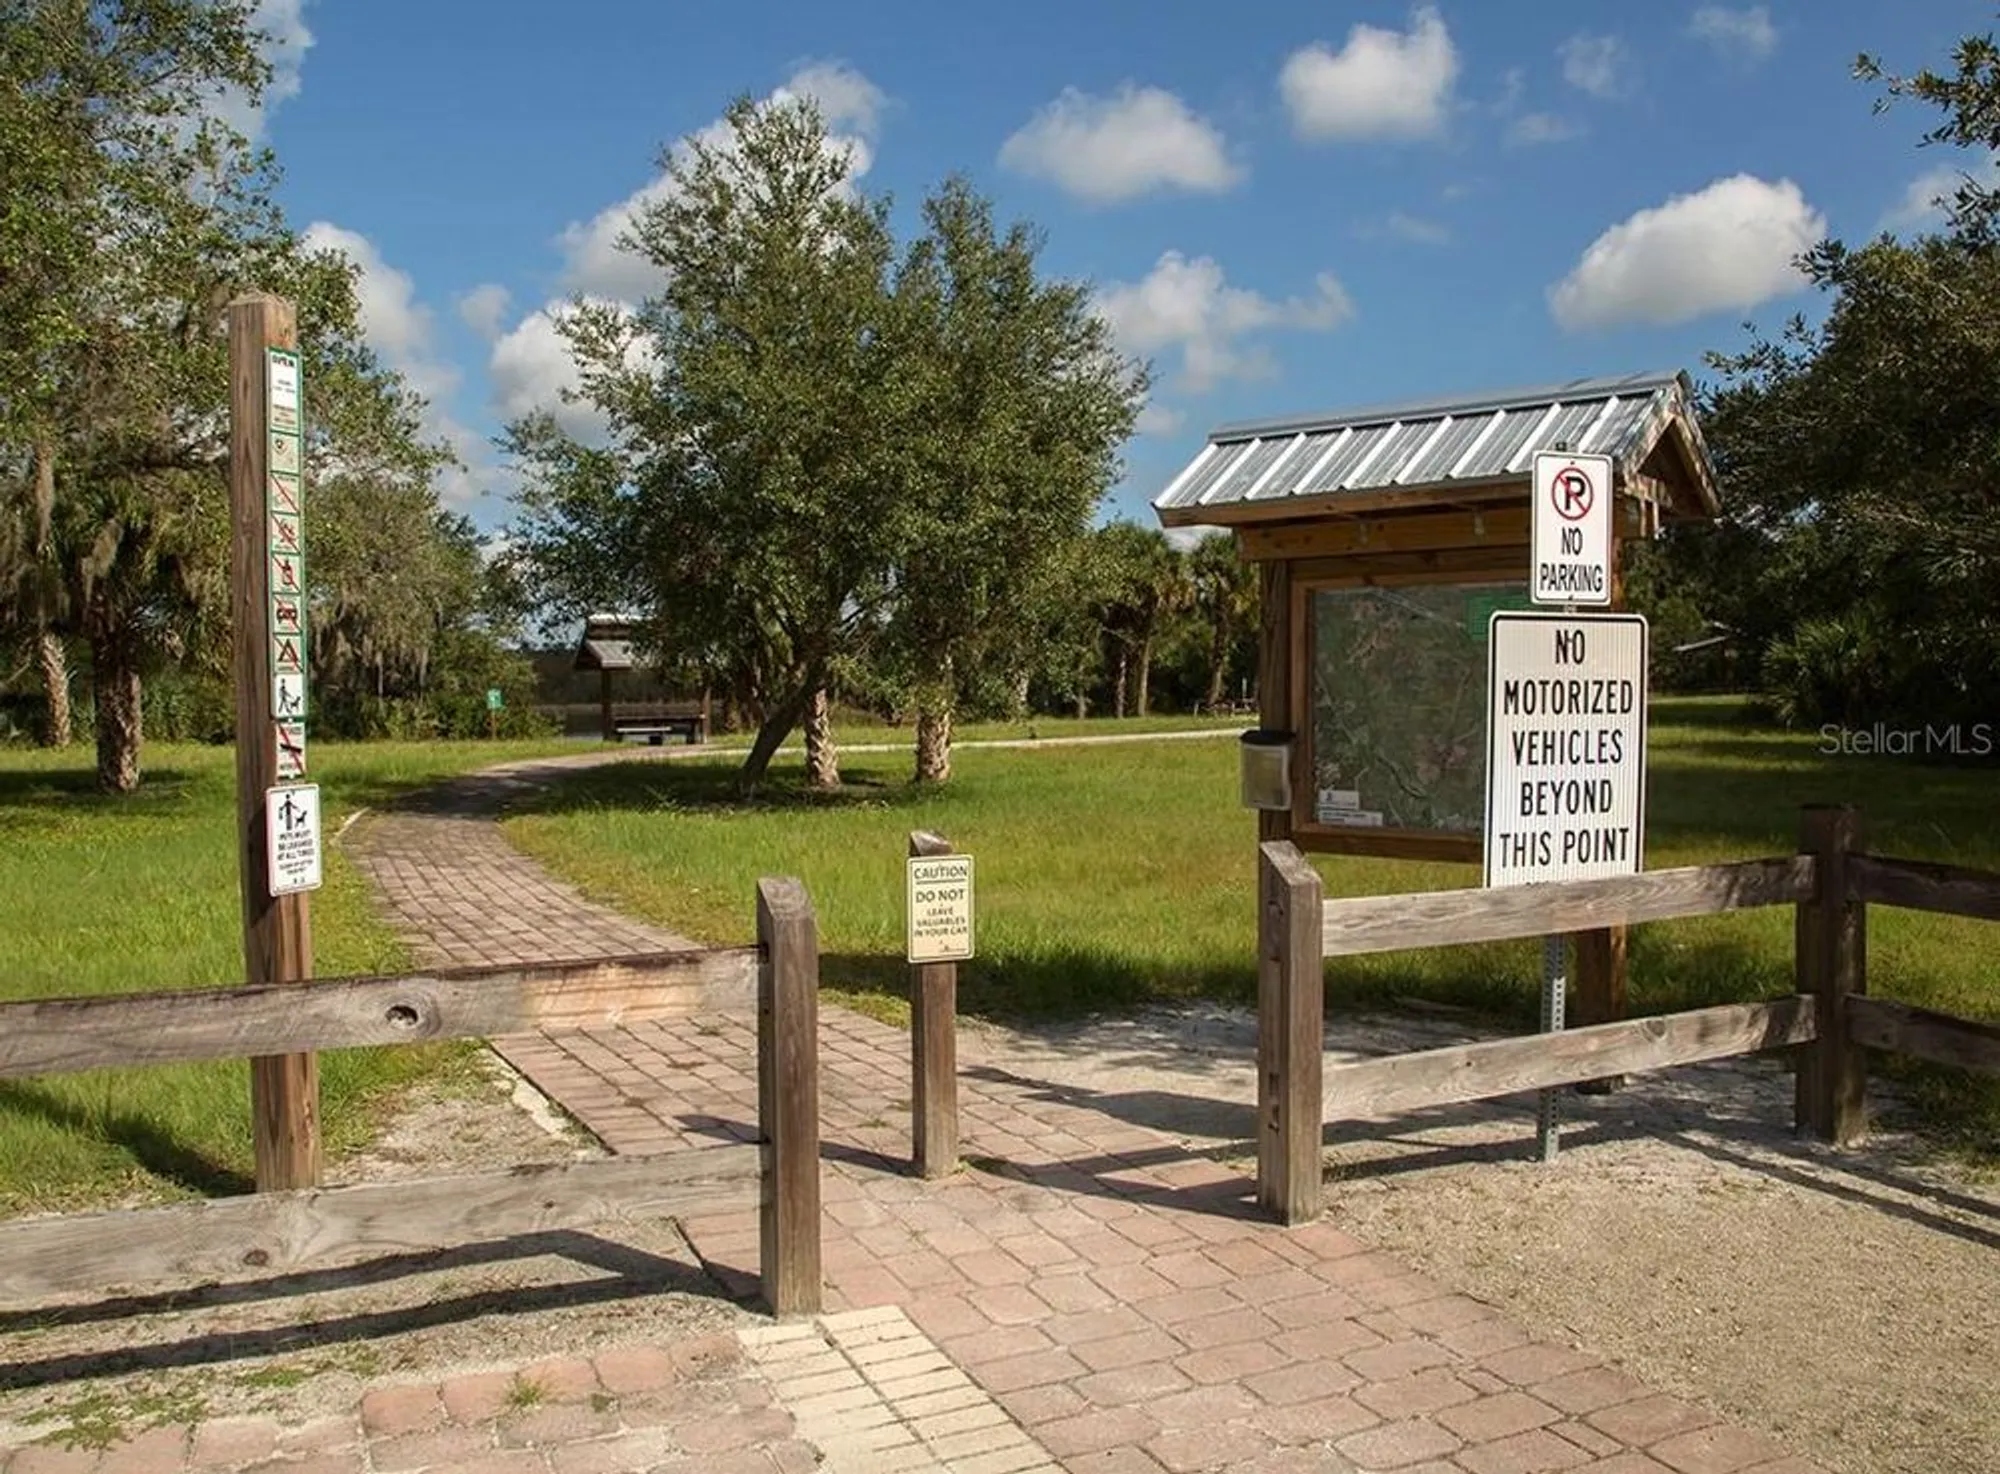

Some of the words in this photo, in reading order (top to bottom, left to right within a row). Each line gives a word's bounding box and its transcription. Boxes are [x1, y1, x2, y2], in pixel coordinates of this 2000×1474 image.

[1561, 526, 1583, 556] NO
[1540, 563, 1604, 593] PARKING
[1555, 629, 1586, 665] NO
[1503, 680, 1633, 715] MOTORIZED
[1512, 729, 1624, 766] VEHICLES
[1520, 779, 1613, 817] BEYOND
[1500, 830, 1552, 868] THIS
[1563, 827, 1630, 865] POINT
[914, 866, 967, 879] CAUTION
[916, 889, 936, 903] DO
[938, 888, 964, 901] NOT
[915, 916, 966, 927] VALUABLES
[926, 906, 953, 916] LEAVE
[914, 929, 923, 937] IN
[924, 927, 949, 937] YOUR
[950, 925, 967, 935] CAR
